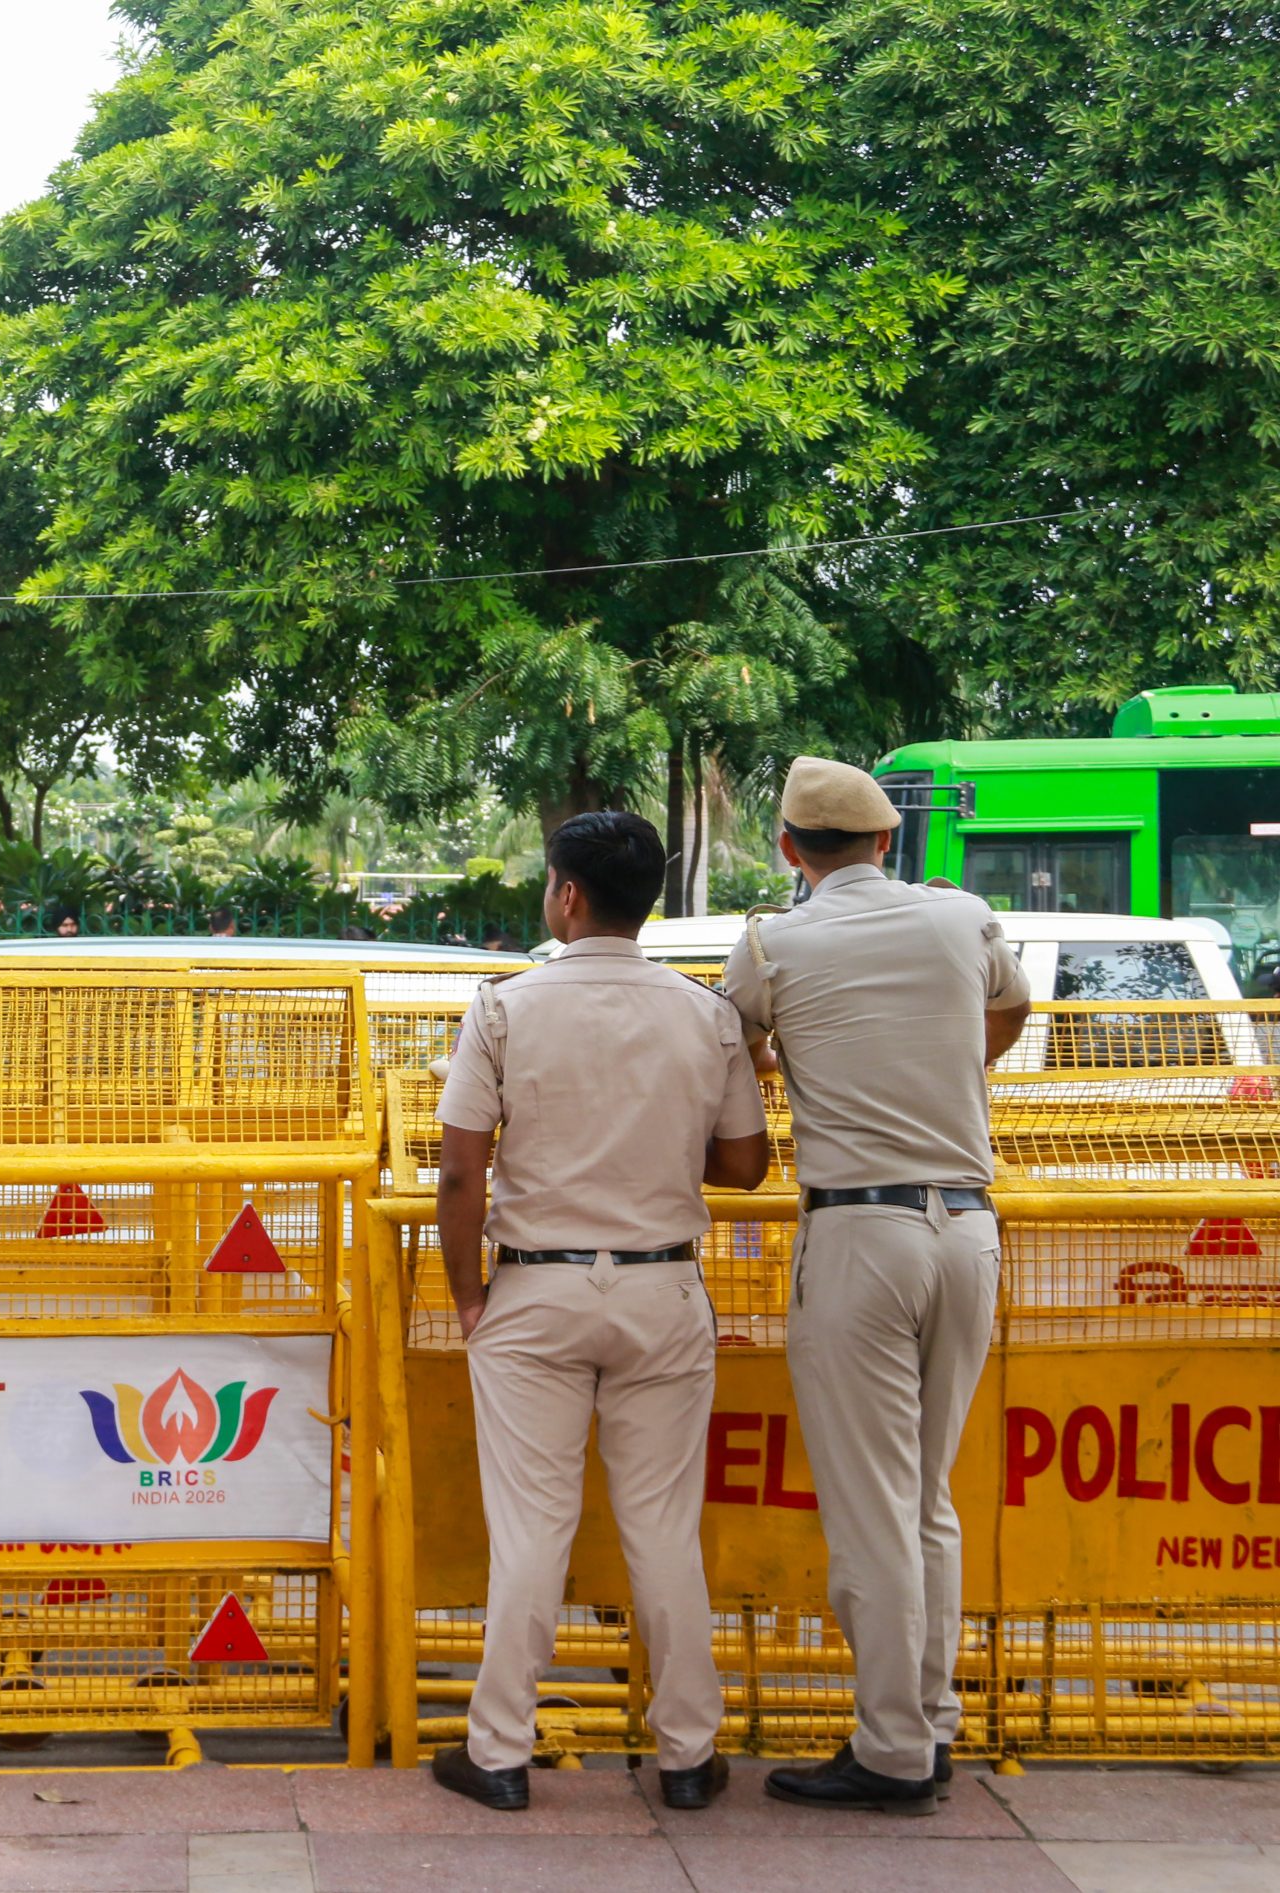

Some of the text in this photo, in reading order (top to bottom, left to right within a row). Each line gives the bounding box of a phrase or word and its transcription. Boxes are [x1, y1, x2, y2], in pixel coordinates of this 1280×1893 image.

[139, 1470, 217, 1487] BRICS
[132, 1490, 226, 1505] INDIA 2026
[1156, 1534, 1280, 1570] NEW DE
